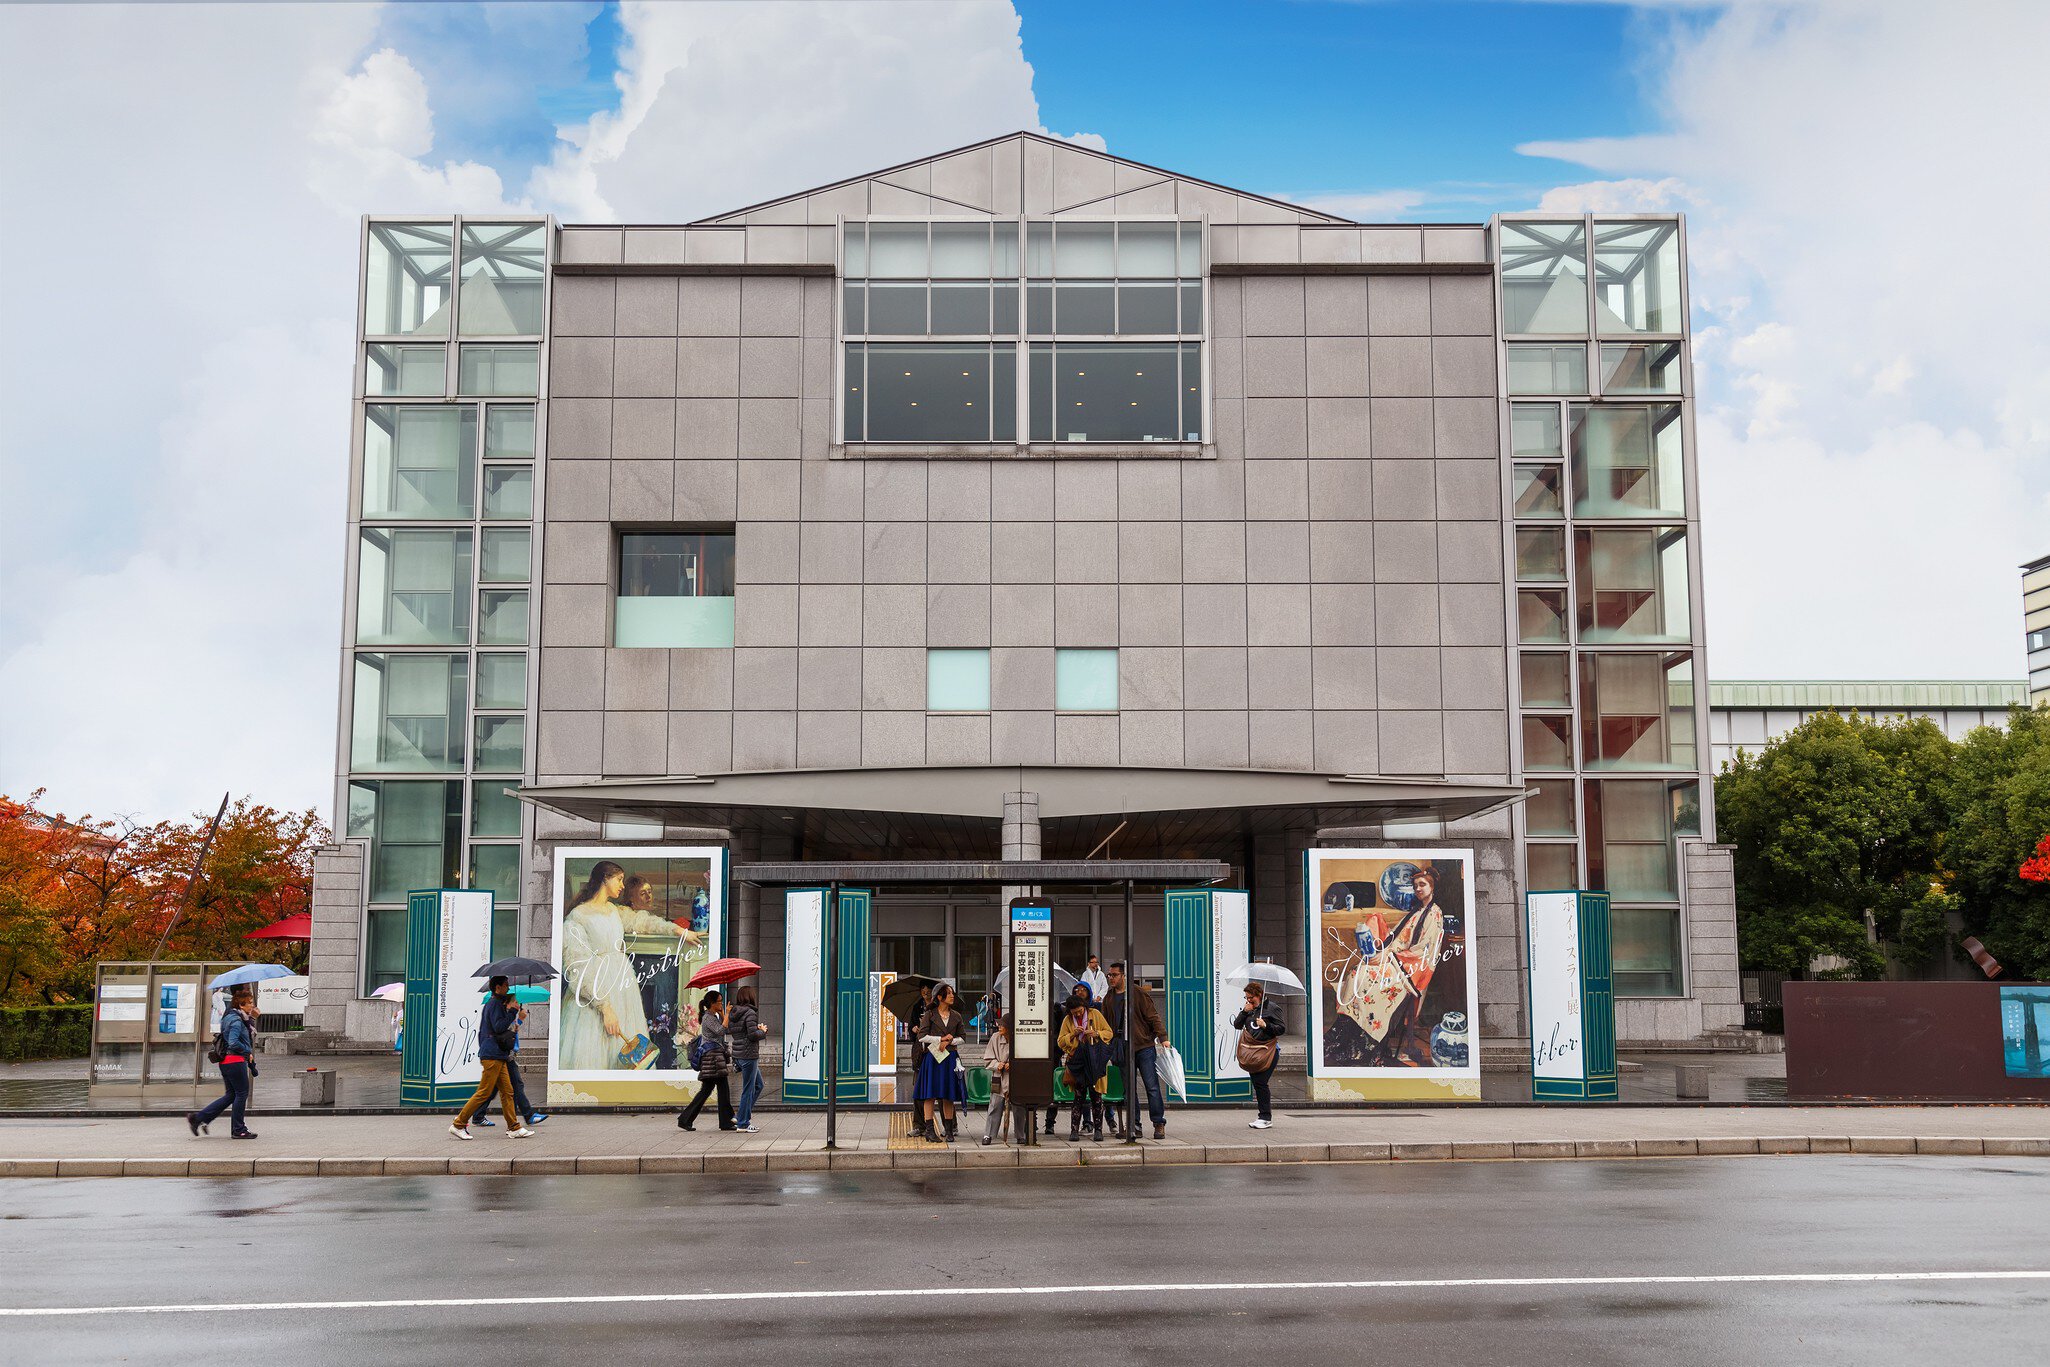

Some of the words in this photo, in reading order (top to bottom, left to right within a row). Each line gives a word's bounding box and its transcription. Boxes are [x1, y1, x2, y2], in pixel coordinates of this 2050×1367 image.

[442, 918, 450, 943] McNeill
[443, 895, 451, 917] James
[564, 926, 708, 1008] Whistler
[811, 895, 821, 1015] ホイッスラー展
[1018, 951, 1026, 989] 平安神宮前
[1324, 926, 1464, 1006] Whistler
[1563, 896, 1579, 1016] ホイッスラー展
[440, 973, 448, 1018] Retrospective
